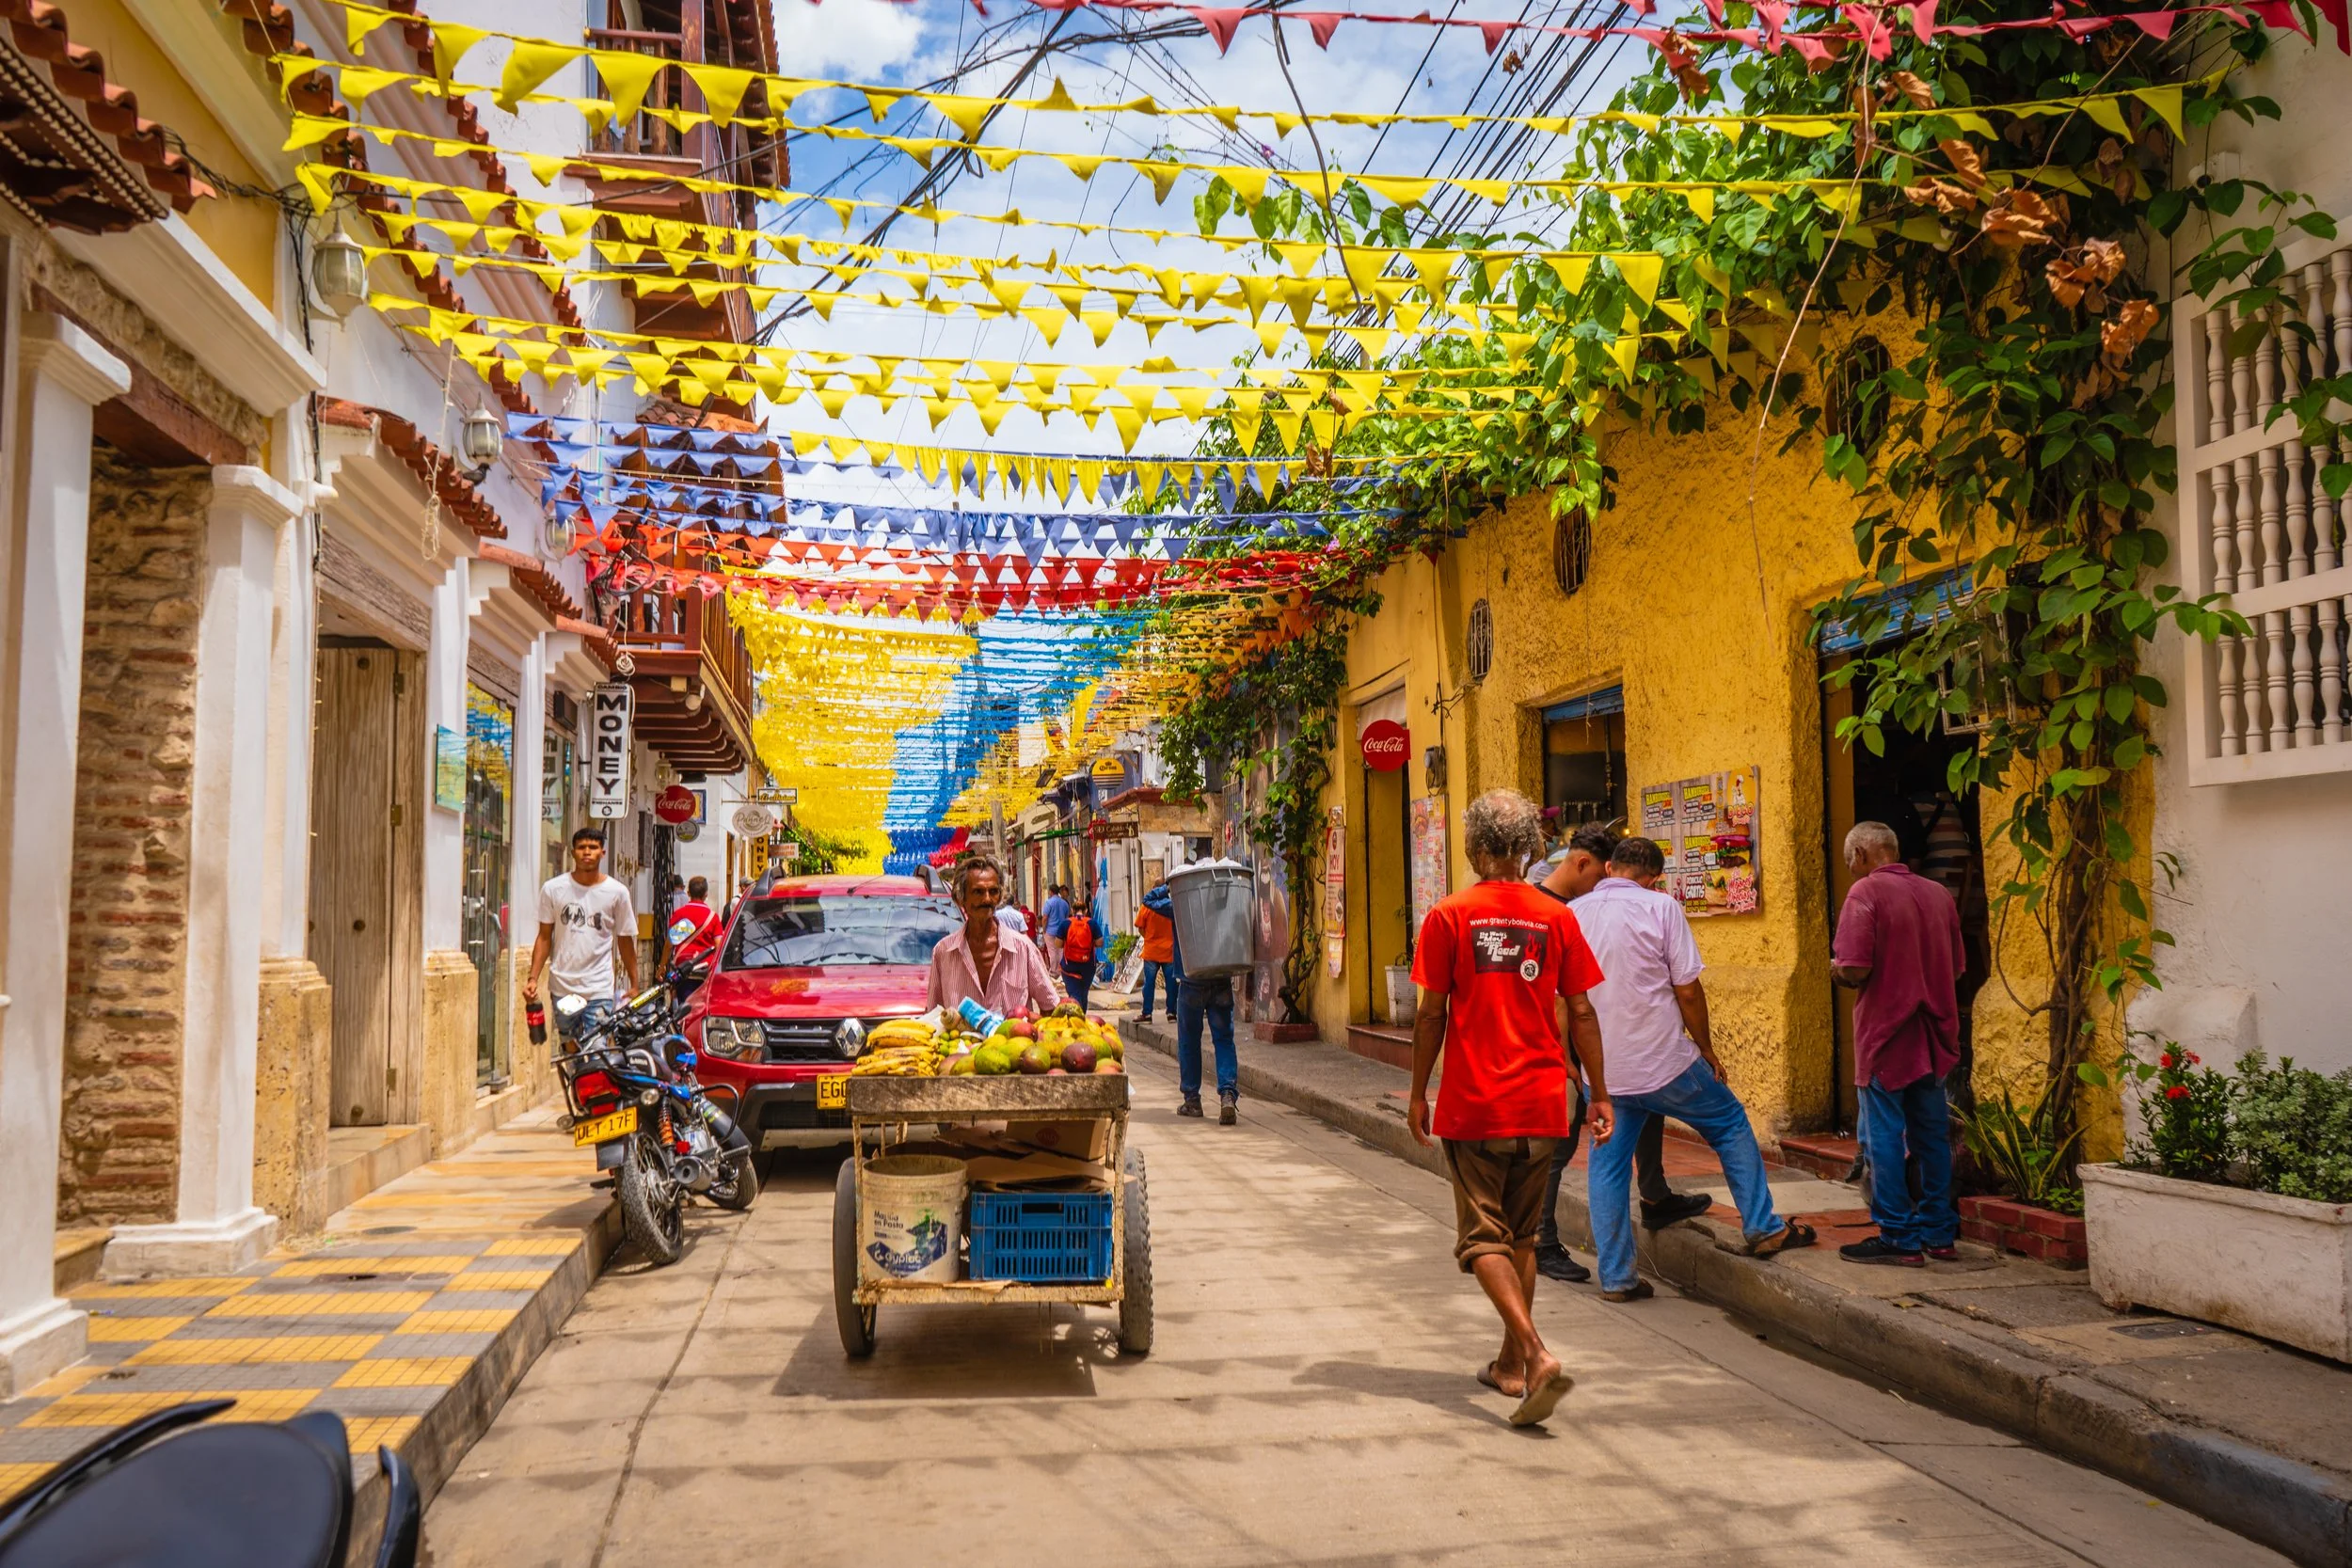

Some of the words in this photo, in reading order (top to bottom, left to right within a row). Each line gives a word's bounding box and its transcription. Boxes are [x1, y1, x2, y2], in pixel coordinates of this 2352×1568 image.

[596, 693, 628, 796] MONEY
[1364, 736, 1405, 752] Coca-Cola
[1470, 917, 1549, 930] www.gravitybolivia.com
[1487, 944, 1520, 962] Road
[609, 1112, 632, 1132] 17F
